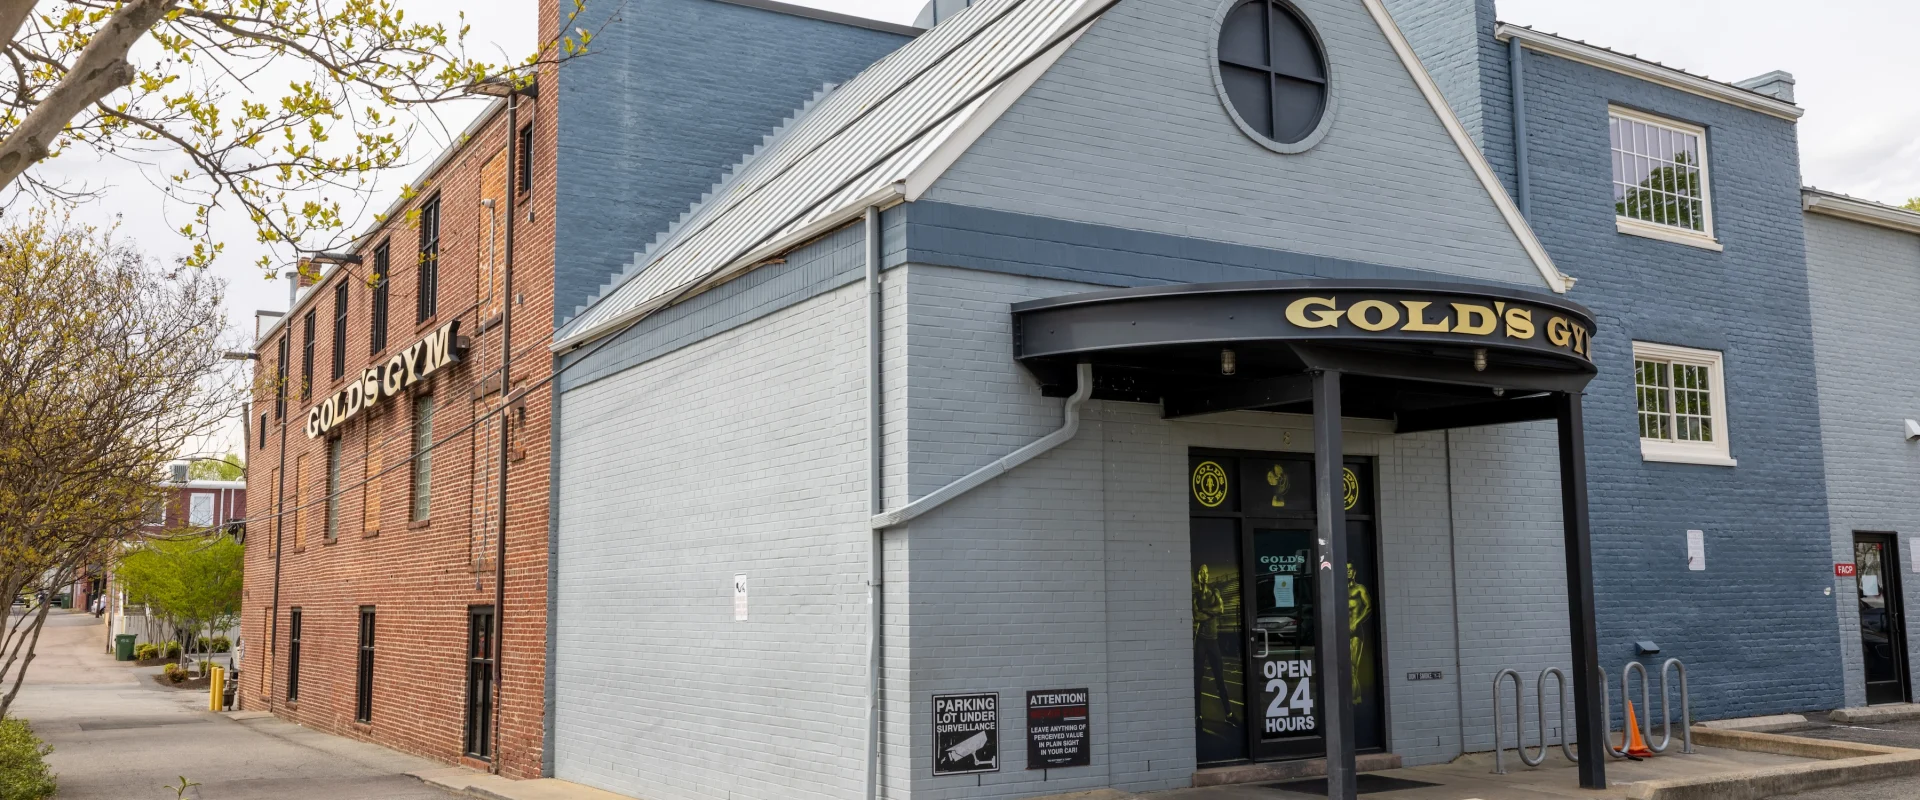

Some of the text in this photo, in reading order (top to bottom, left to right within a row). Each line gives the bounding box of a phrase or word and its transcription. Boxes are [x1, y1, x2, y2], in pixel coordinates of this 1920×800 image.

[1285, 296, 1535, 339] GOLD'S
[307, 320, 453, 439] GOLD'S GYM
[1196, 465, 1224, 485] GOLD'S
[1199, 490, 1224, 503] GYM
[1260, 555, 1305, 564] GOLD'S
[1269, 564, 1297, 572] GYM
[1838, 565, 1853, 574] FACP
[1263, 660, 1312, 679] OPEN
[1030, 693, 1086, 705] ATTENTION!
[1265, 677, 1314, 717] 24
[936, 698, 995, 713] PARKING
[937, 711, 995, 724] LOT UNDER
[1265, 716, 1315, 733] HOURS
[936, 722, 995, 733] SURVEILLANCE
